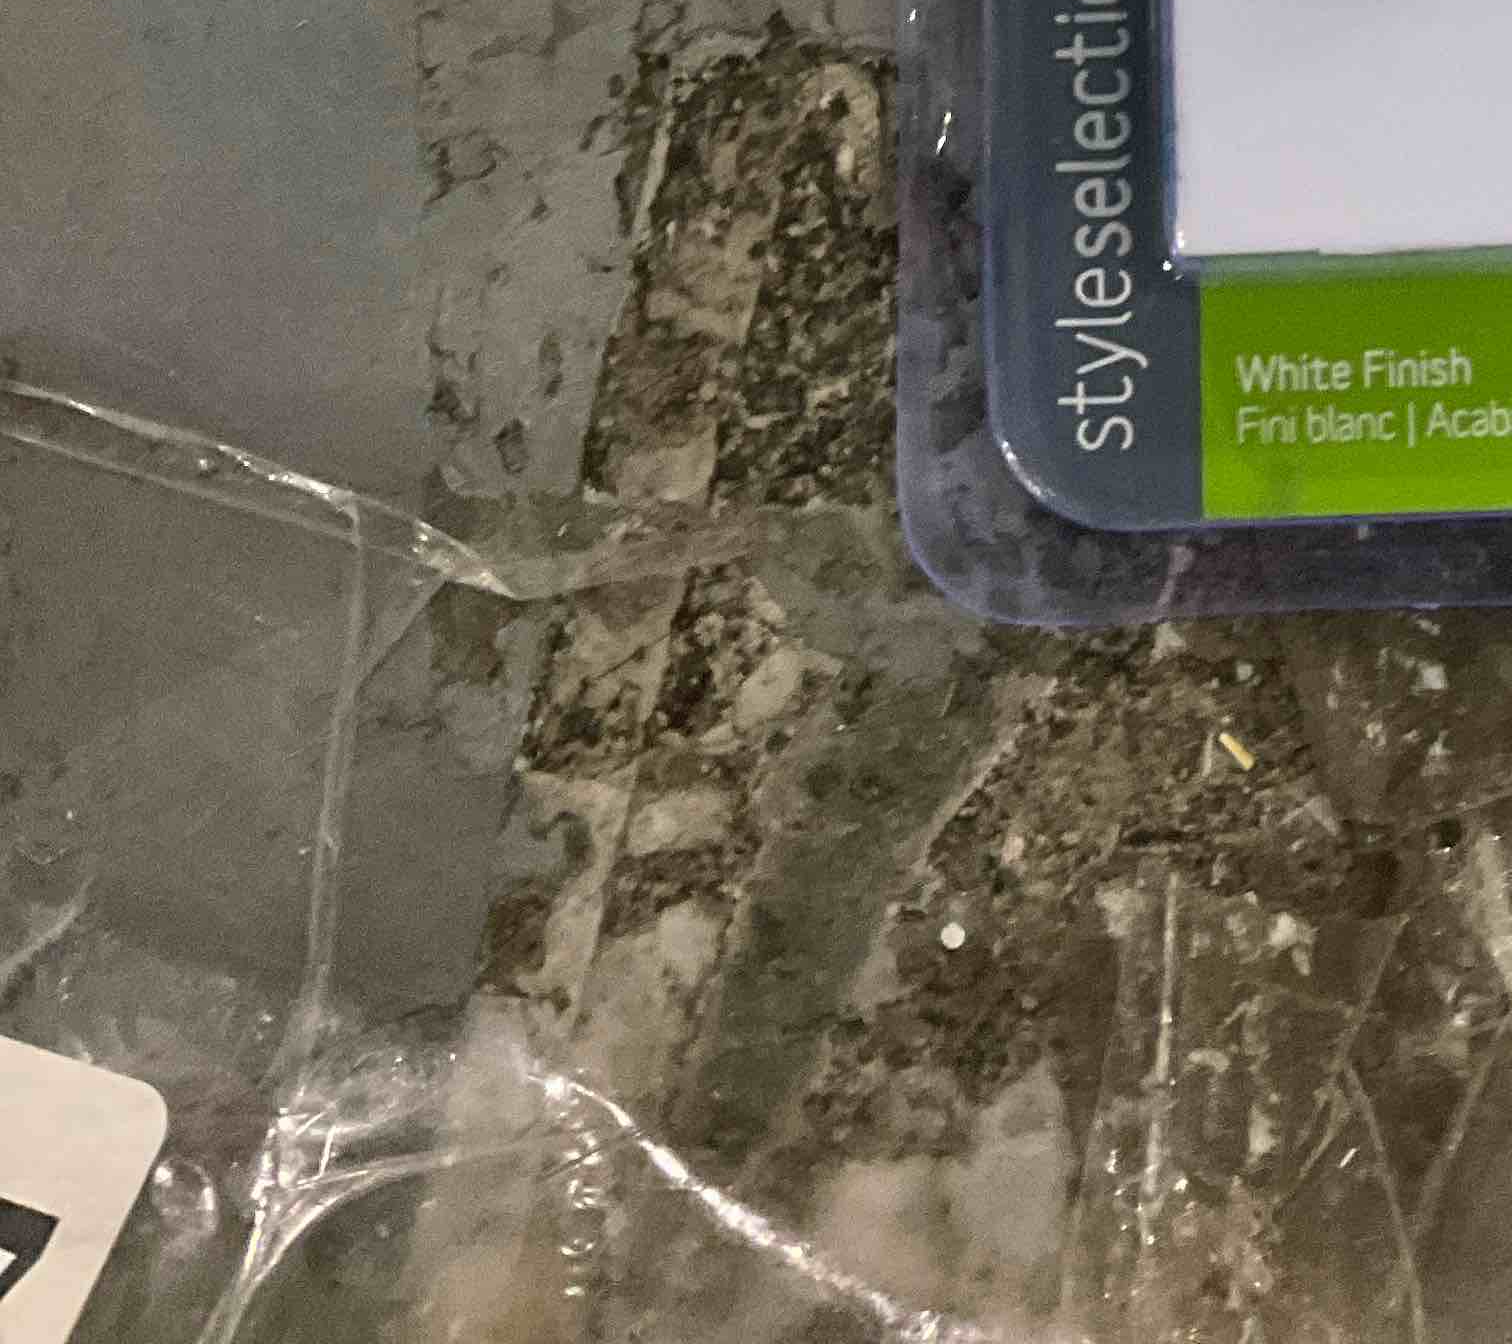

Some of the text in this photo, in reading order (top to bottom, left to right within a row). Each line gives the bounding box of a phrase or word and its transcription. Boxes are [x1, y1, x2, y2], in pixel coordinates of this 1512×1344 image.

[1236, 346, 1473, 393] White Finish
[1237, 405, 1298, 445] Fini
[1306, 404, 1396, 444] blanc
